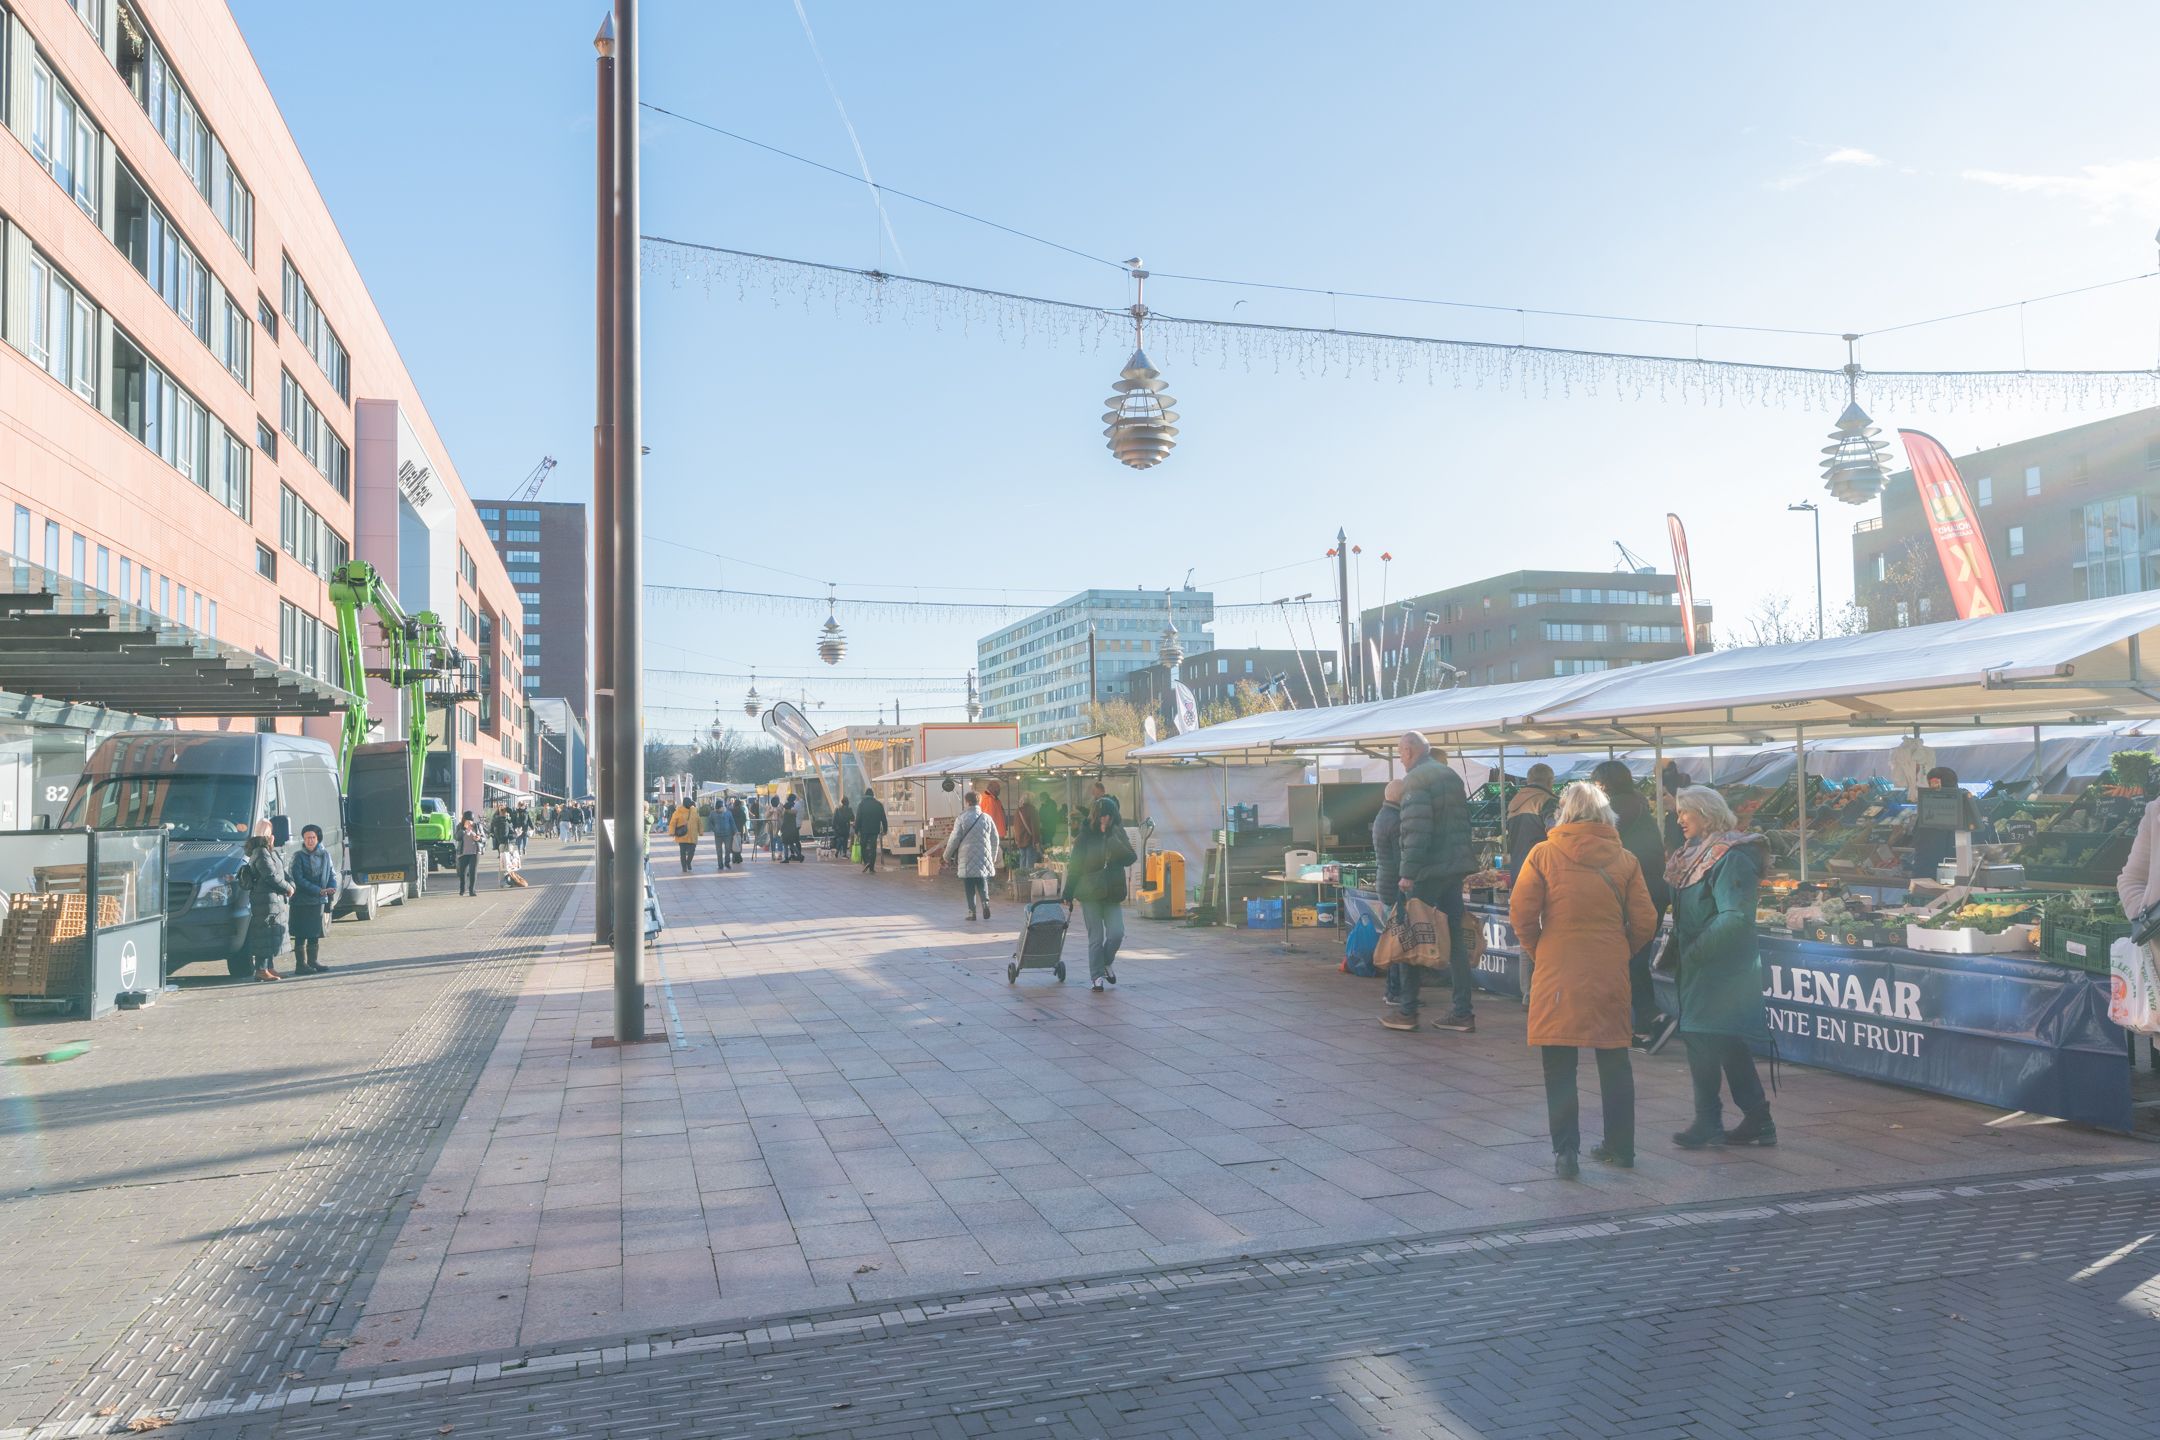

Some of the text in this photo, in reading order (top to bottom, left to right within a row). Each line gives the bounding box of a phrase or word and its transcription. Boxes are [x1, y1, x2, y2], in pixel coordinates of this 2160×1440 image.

[46, 785, 69, 802] 82
[1762, 965, 1923, 1022] LENAAR
[1765, 1006, 1924, 1058] NTE EN FRUIT
